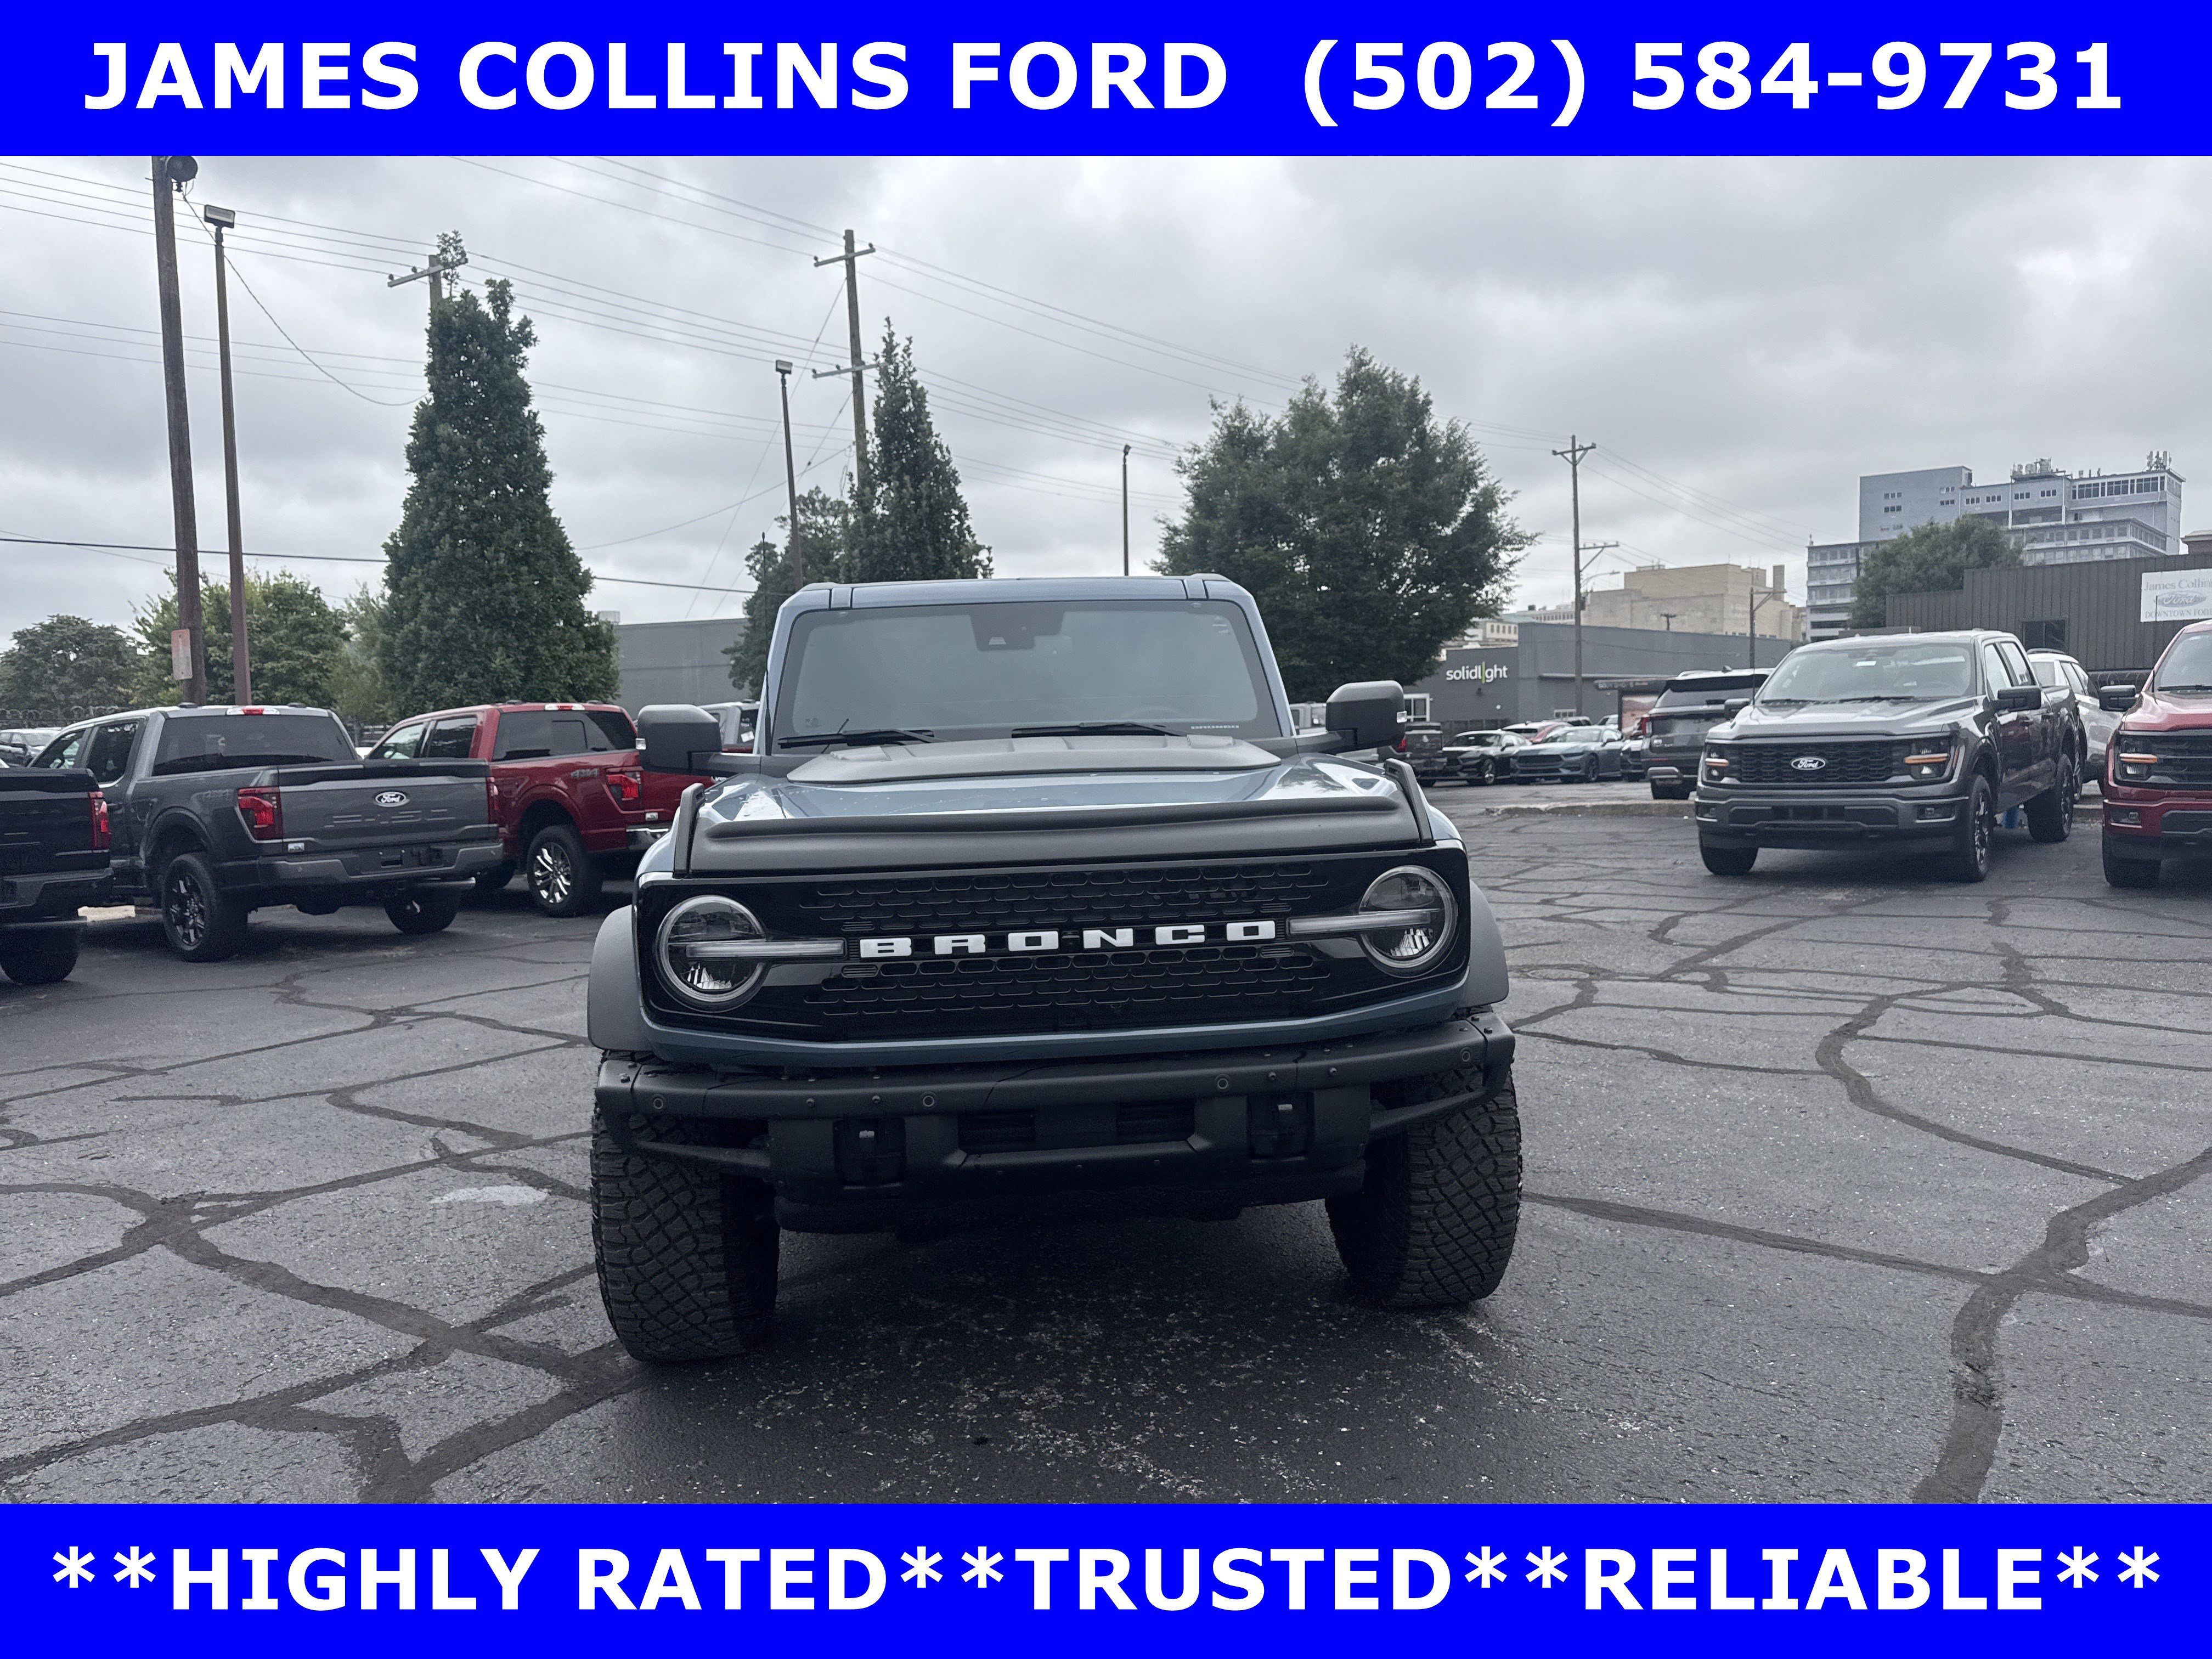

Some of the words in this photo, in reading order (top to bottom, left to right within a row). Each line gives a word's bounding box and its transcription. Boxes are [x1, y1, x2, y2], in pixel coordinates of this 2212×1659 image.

[2145, 582, 2176, 591] James
[2178, 579, 2212, 589] Collin
[860, 920, 1276, 958] BRONCO
